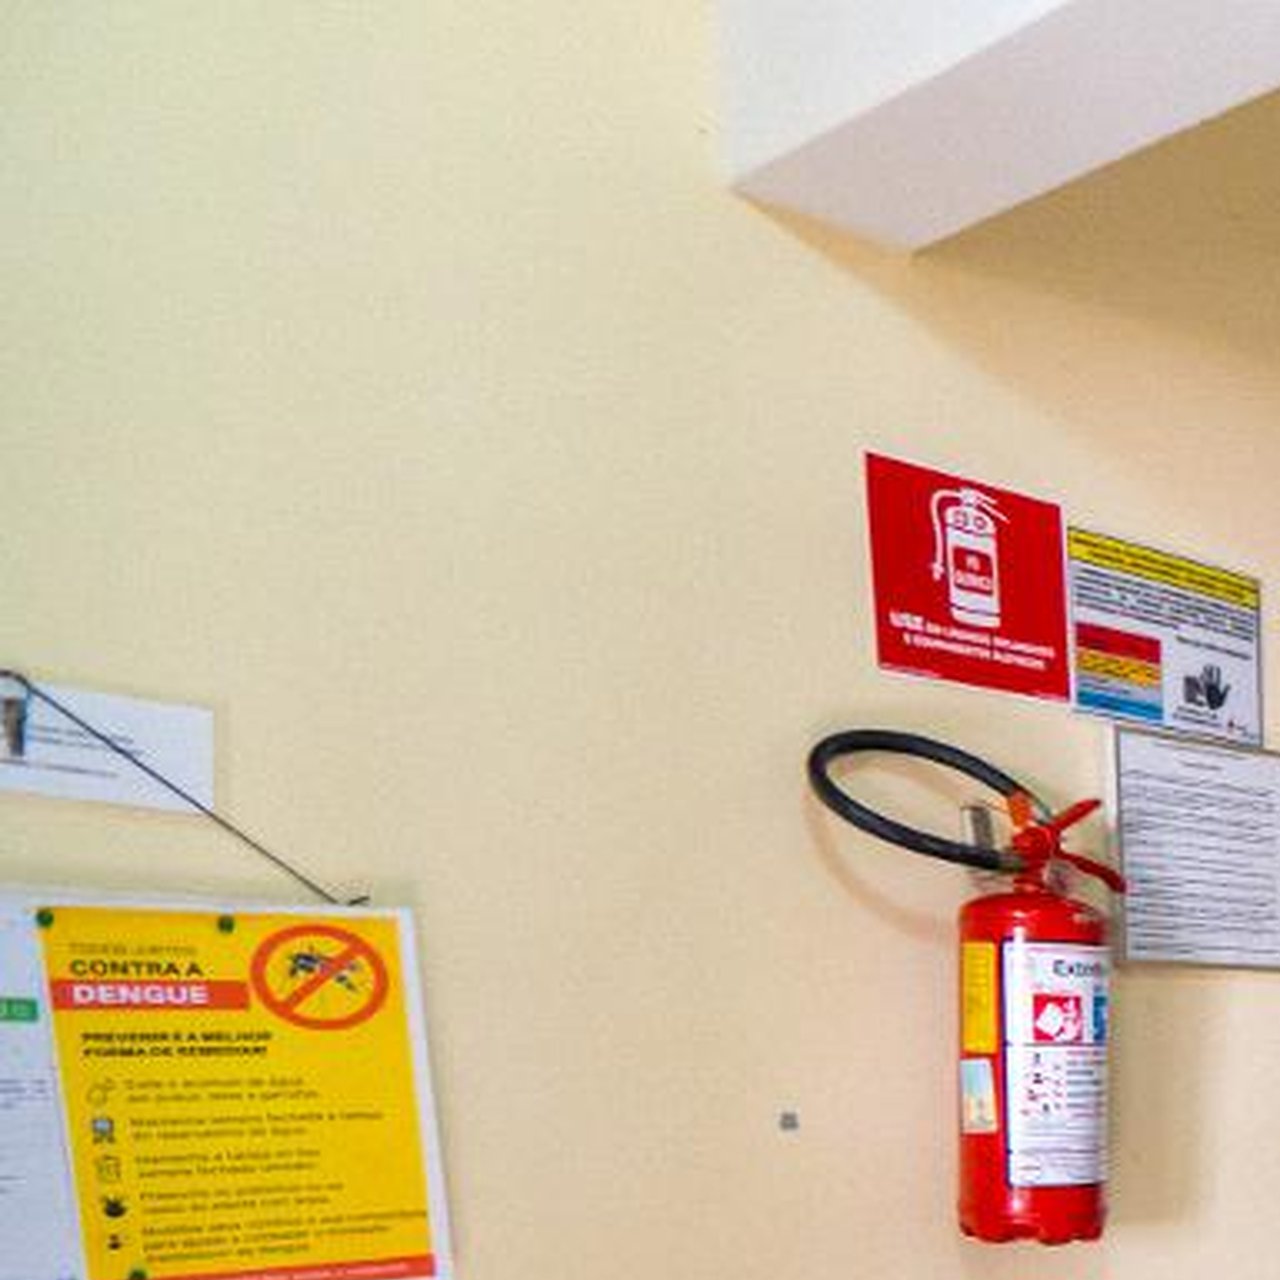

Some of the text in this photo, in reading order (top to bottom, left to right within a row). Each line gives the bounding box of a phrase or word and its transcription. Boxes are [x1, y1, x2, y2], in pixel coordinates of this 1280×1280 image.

[70, 959, 202, 976] CONTRA A
[72, 984, 208, 1004] DENGUE
